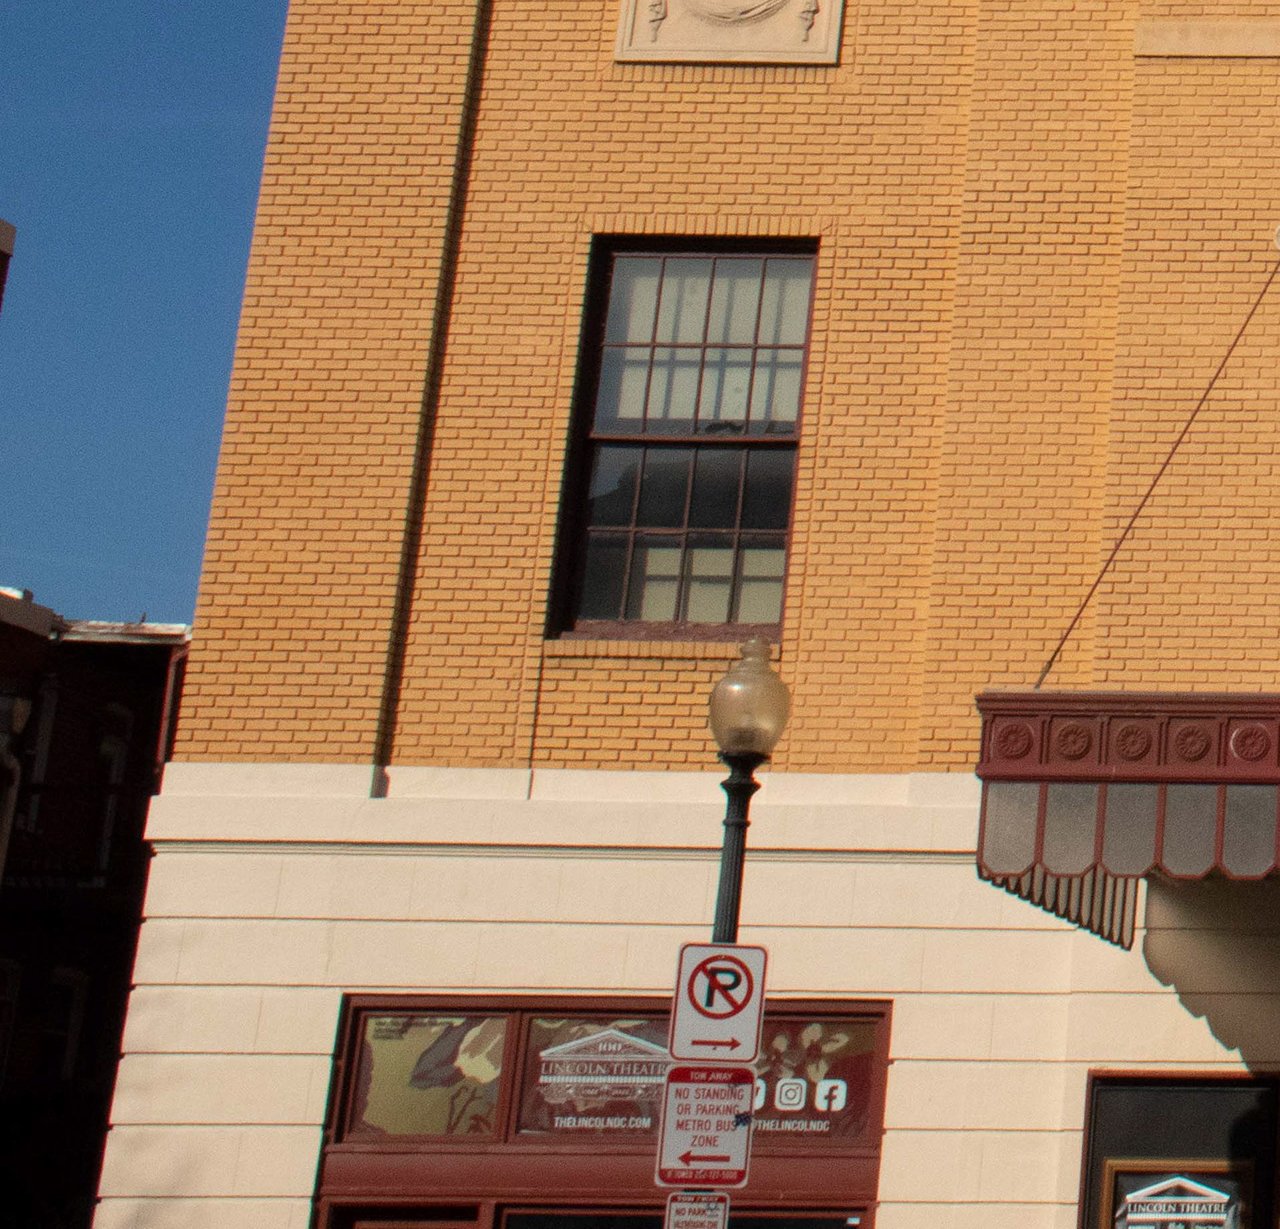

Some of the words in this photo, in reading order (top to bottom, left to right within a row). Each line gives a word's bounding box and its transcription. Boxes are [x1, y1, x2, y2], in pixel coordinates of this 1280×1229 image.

[541, 1061, 606, 1075] LINCOLN
[613, 1061, 667, 1075] THEATR
[675, 1088, 690, 1100] NO
[694, 1087, 744, 1101] STANDING
[676, 1104, 692, 1114] OR
[695, 1104, 740, 1115] PARKING
[554, 1116, 652, 1128] THELINCOLNDC.COM
[676, 1119, 711, 1131] METRO
[716, 1120, 738, 1132] BUS
[690, 1135, 719, 1147] ZONE
[1128, 1203, 1177, 1212] LINCOLN
[1180, 1202, 1227, 1212] THEATRE
